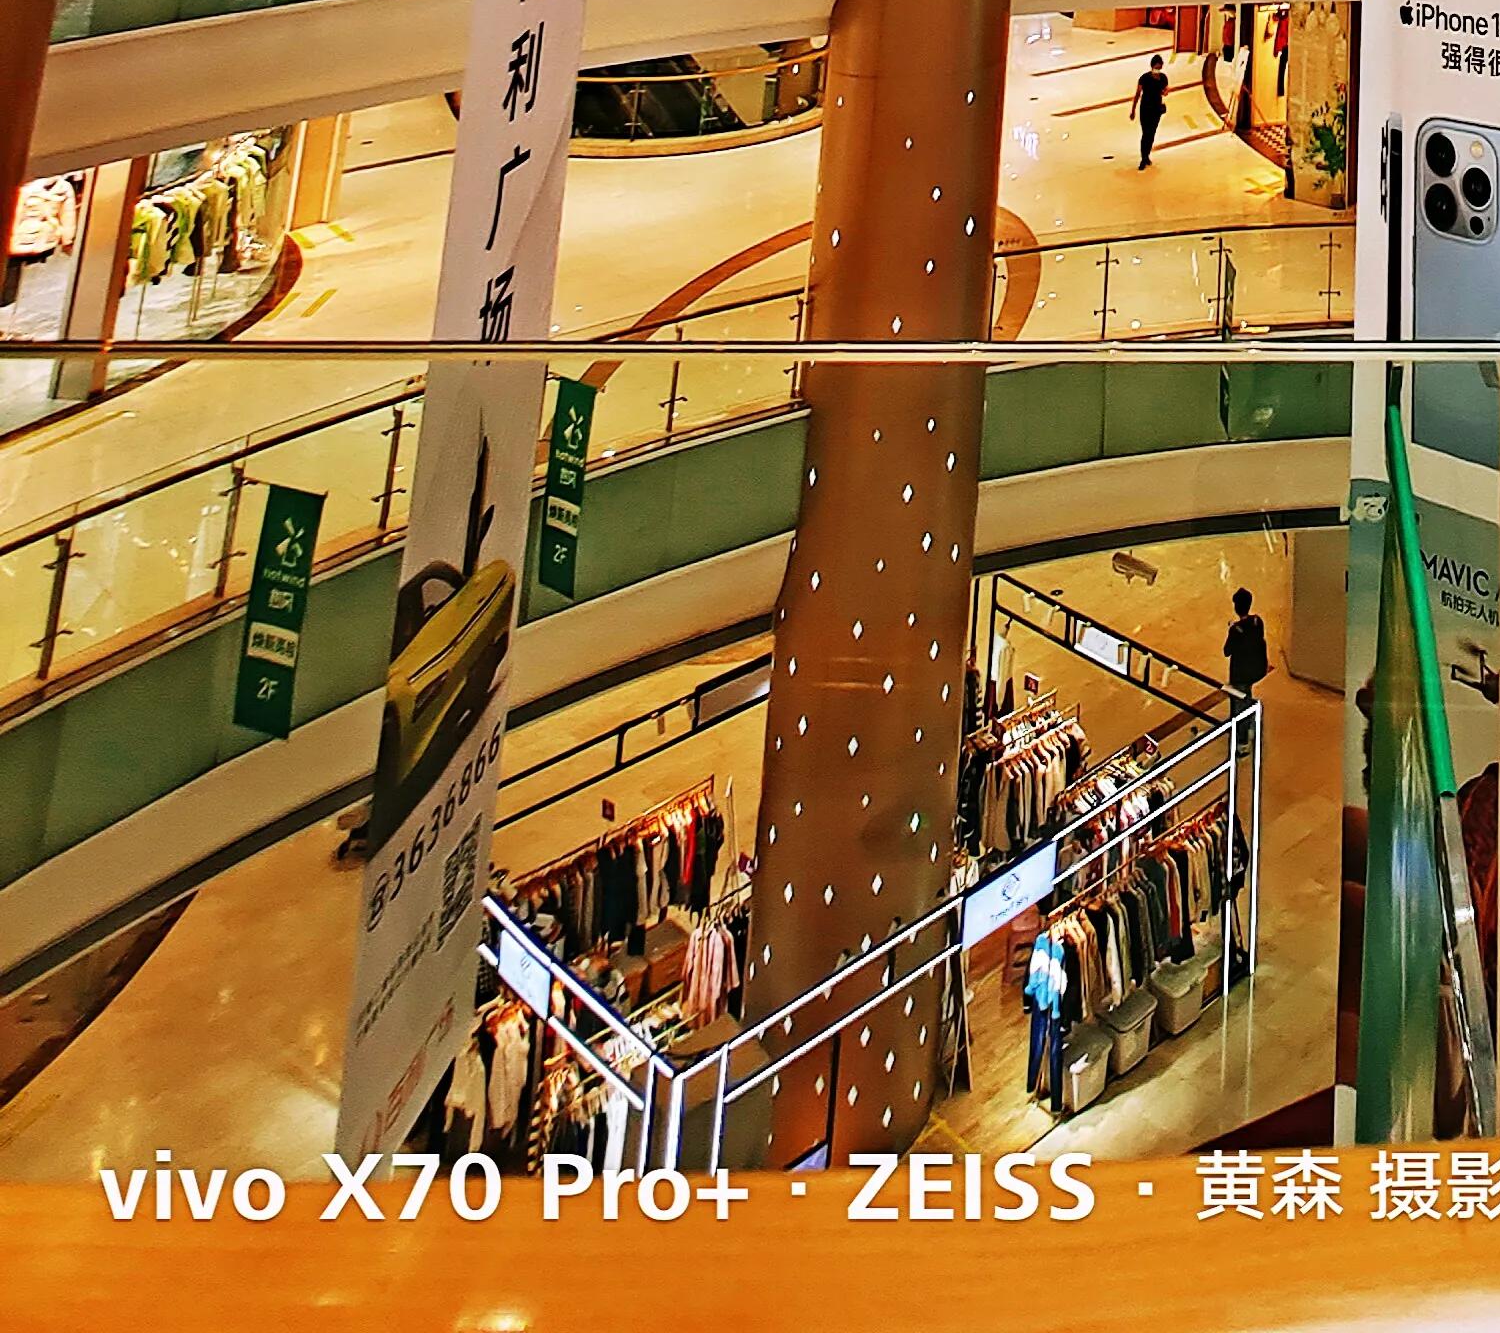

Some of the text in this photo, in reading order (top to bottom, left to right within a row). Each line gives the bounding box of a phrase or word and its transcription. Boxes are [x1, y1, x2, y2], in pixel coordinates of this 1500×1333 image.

[1416, 2, 1489, 36] iPhone
[1420, 549, 1490, 597] MAVIC
[1440, 590, 1500, 627] 航拍无人机
[256, 677, 278, 700] 2F
